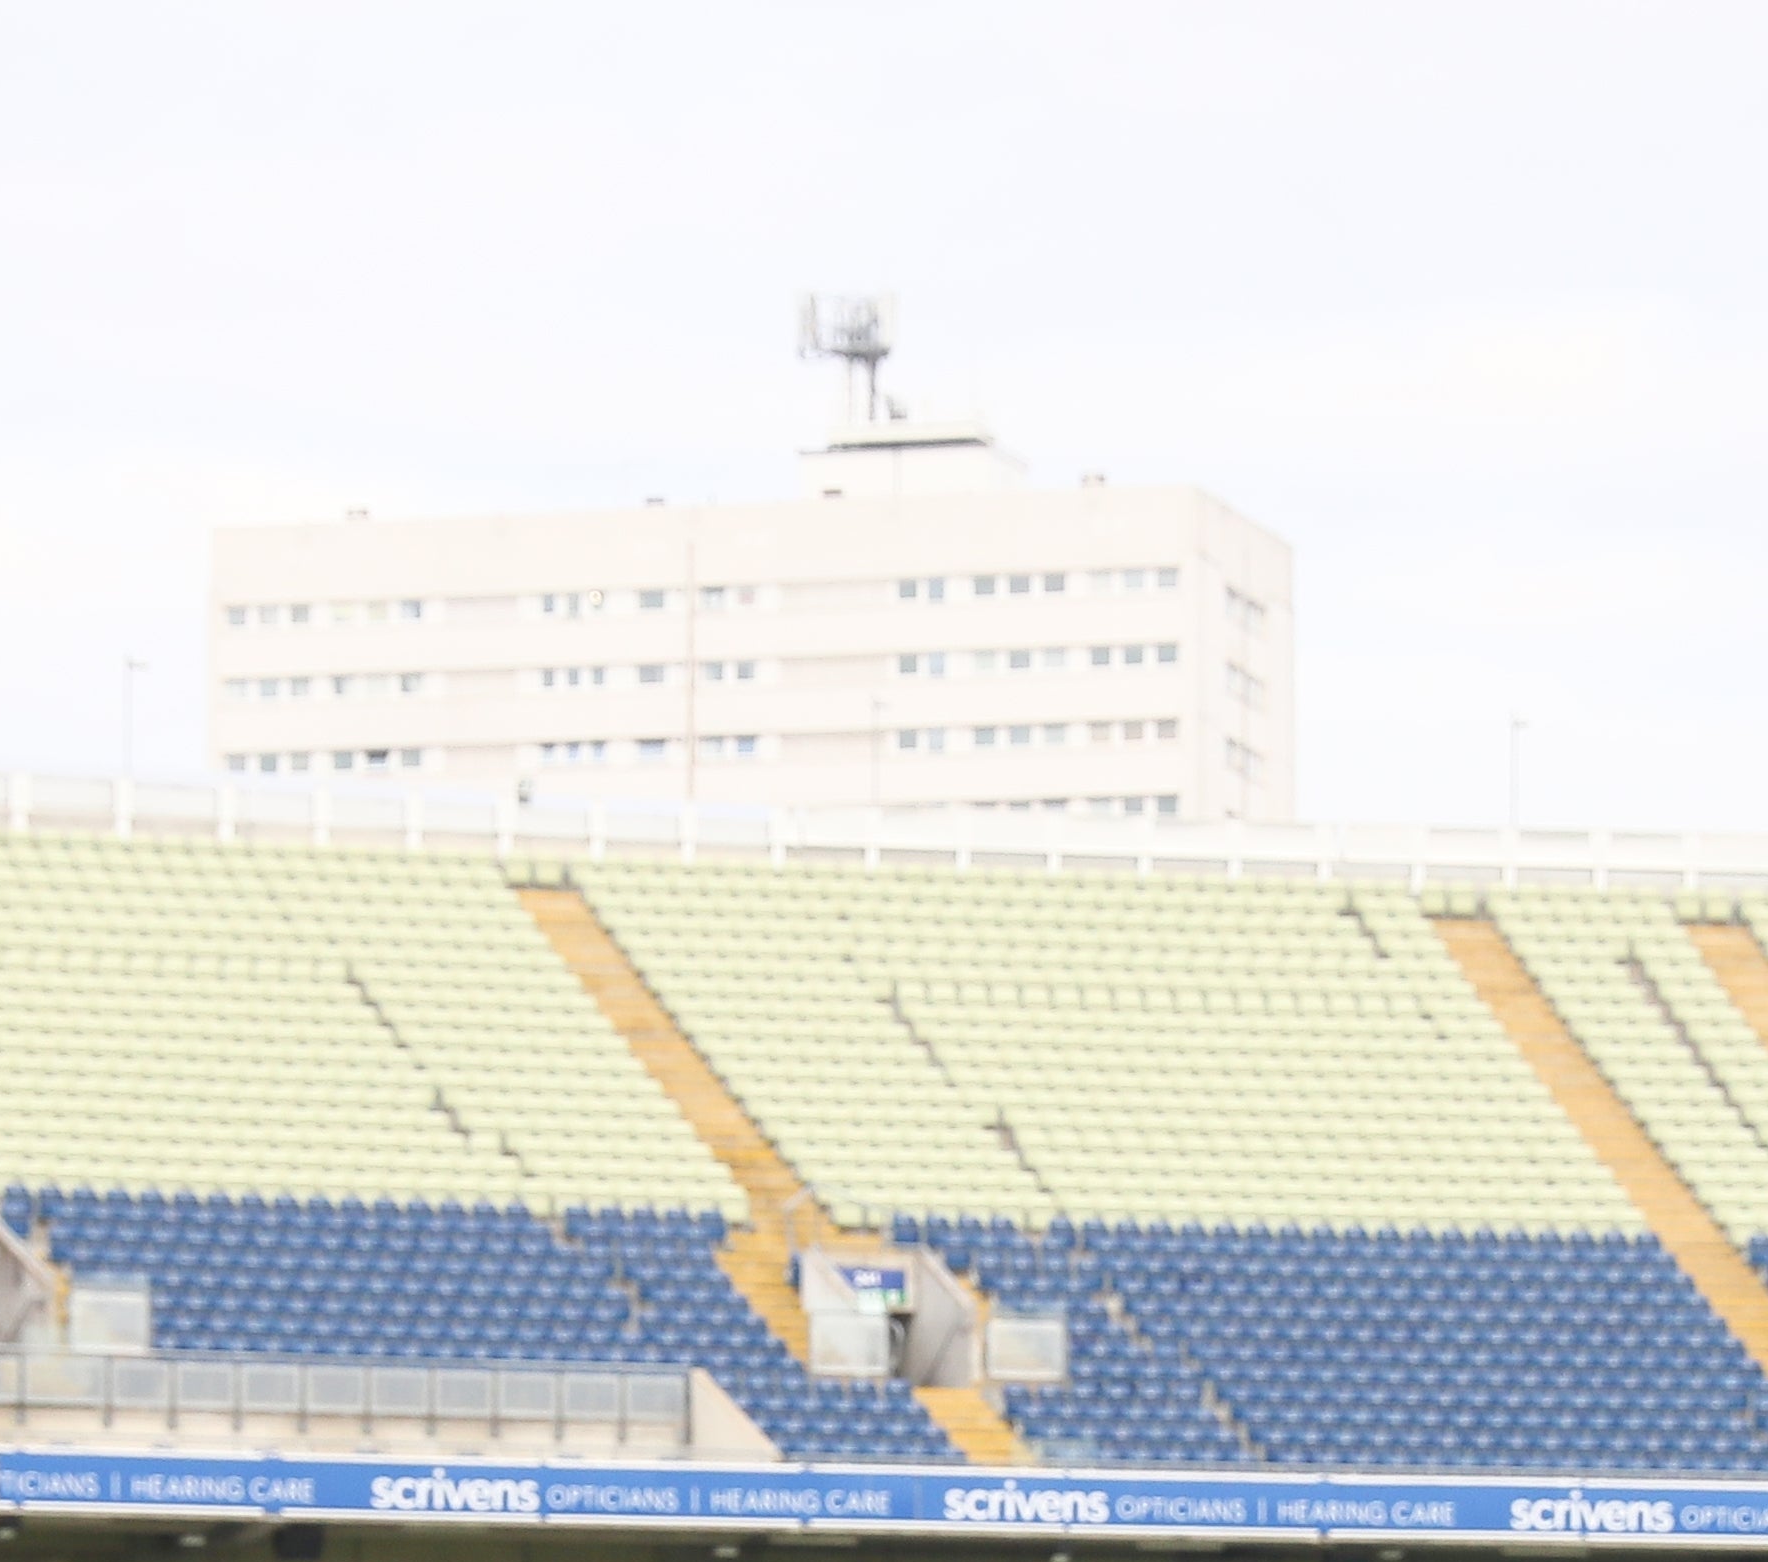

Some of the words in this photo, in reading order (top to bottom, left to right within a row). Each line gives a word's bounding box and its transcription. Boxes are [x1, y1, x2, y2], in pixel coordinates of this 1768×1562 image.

[131, 1473, 243, 1501] HEARING
[249, 1475, 315, 1503] CARE
[370, 1468, 539, 1511] scrivens
[546, 1484, 678, 1512] OPTICIANS
[710, 1487, 821, 1514] HEARING
[825, 1488, 890, 1515] CARE
[943, 1480, 1109, 1522] scrivens
[1115, 1494, 1246, 1523] OPTICIANS
[1277, 1498, 1386, 1525] HEARING
[1391, 1500, 1455, 1526] CARE
[1510, 1490, 1674, 1532] scrivens
